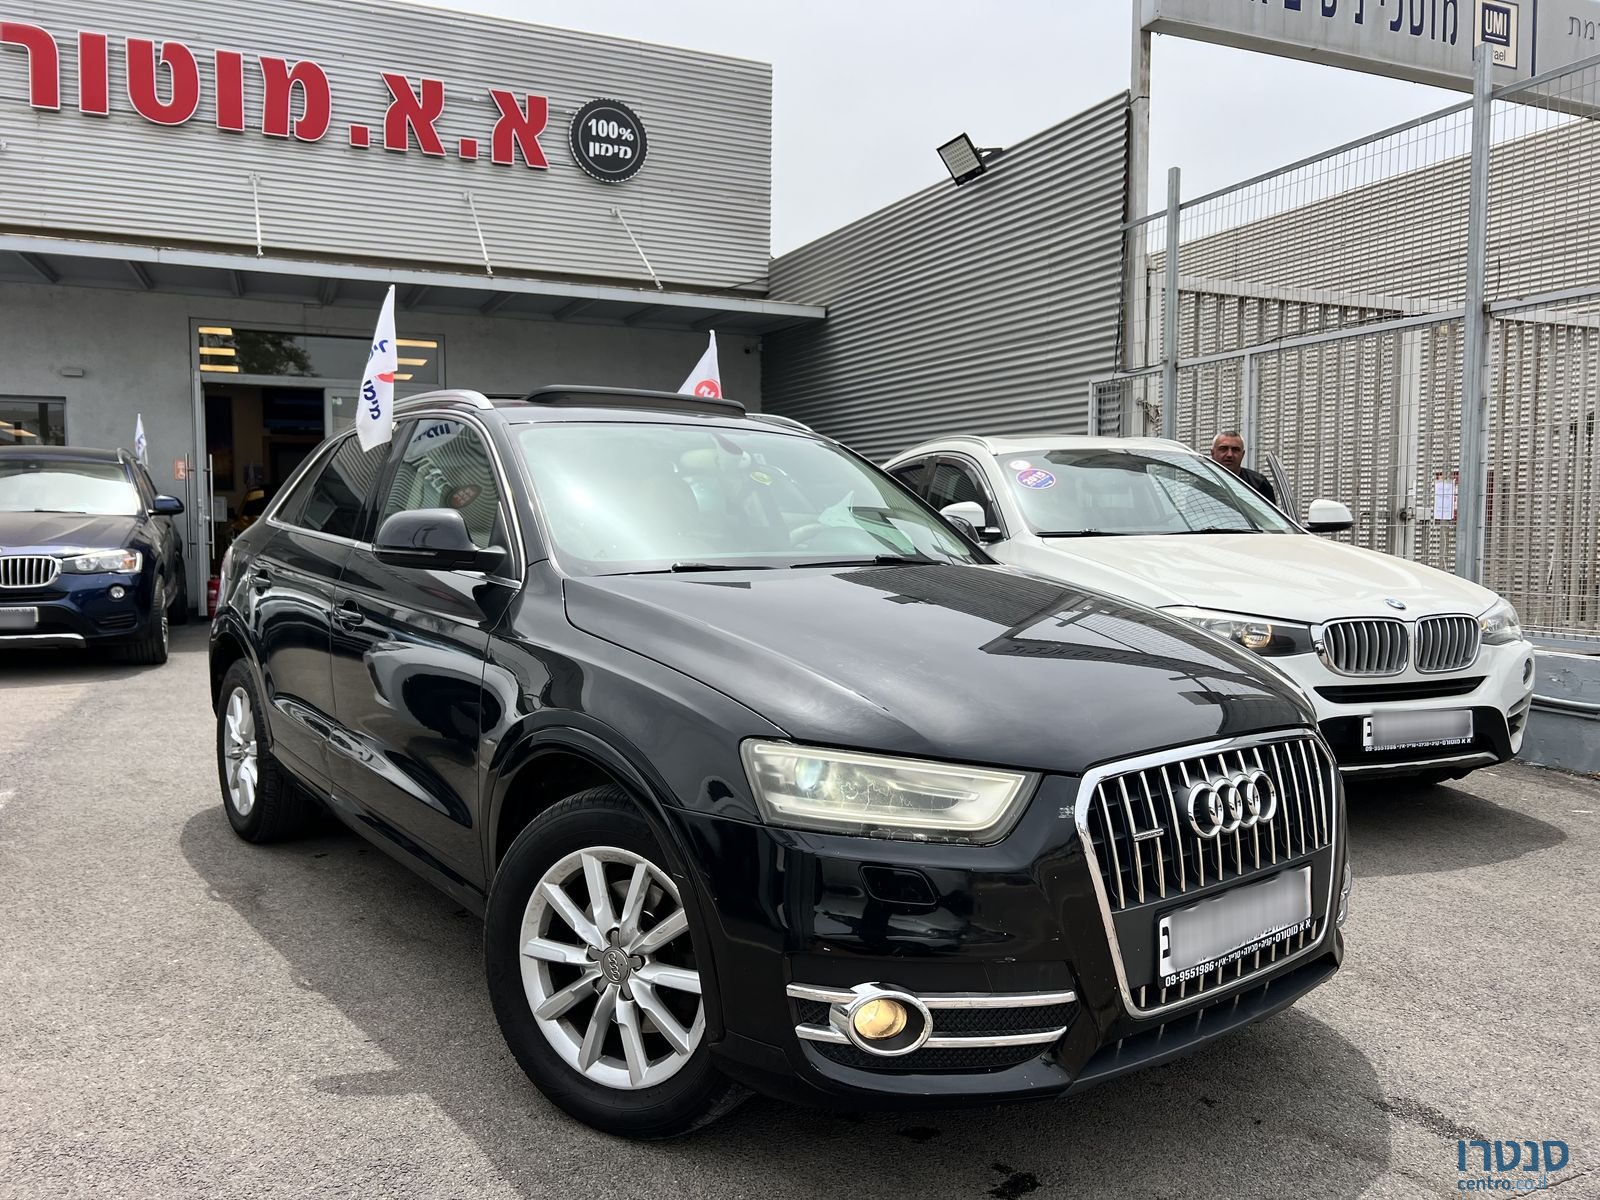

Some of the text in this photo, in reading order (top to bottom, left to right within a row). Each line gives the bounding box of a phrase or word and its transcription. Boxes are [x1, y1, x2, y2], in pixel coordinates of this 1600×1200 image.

[1485, 9, 1507, 36] UMI
[1568, 16, 1600, 41] מת
[588, 118, 634, 141] 100%
[588, 141, 632, 159] מימון
[1275, 925, 1298, 942] מוטורס
[1299, 923, 1304, 931] א
[1306, 919, 1311, 928] א
[1165, 961, 1215, 988] 09-9551986
